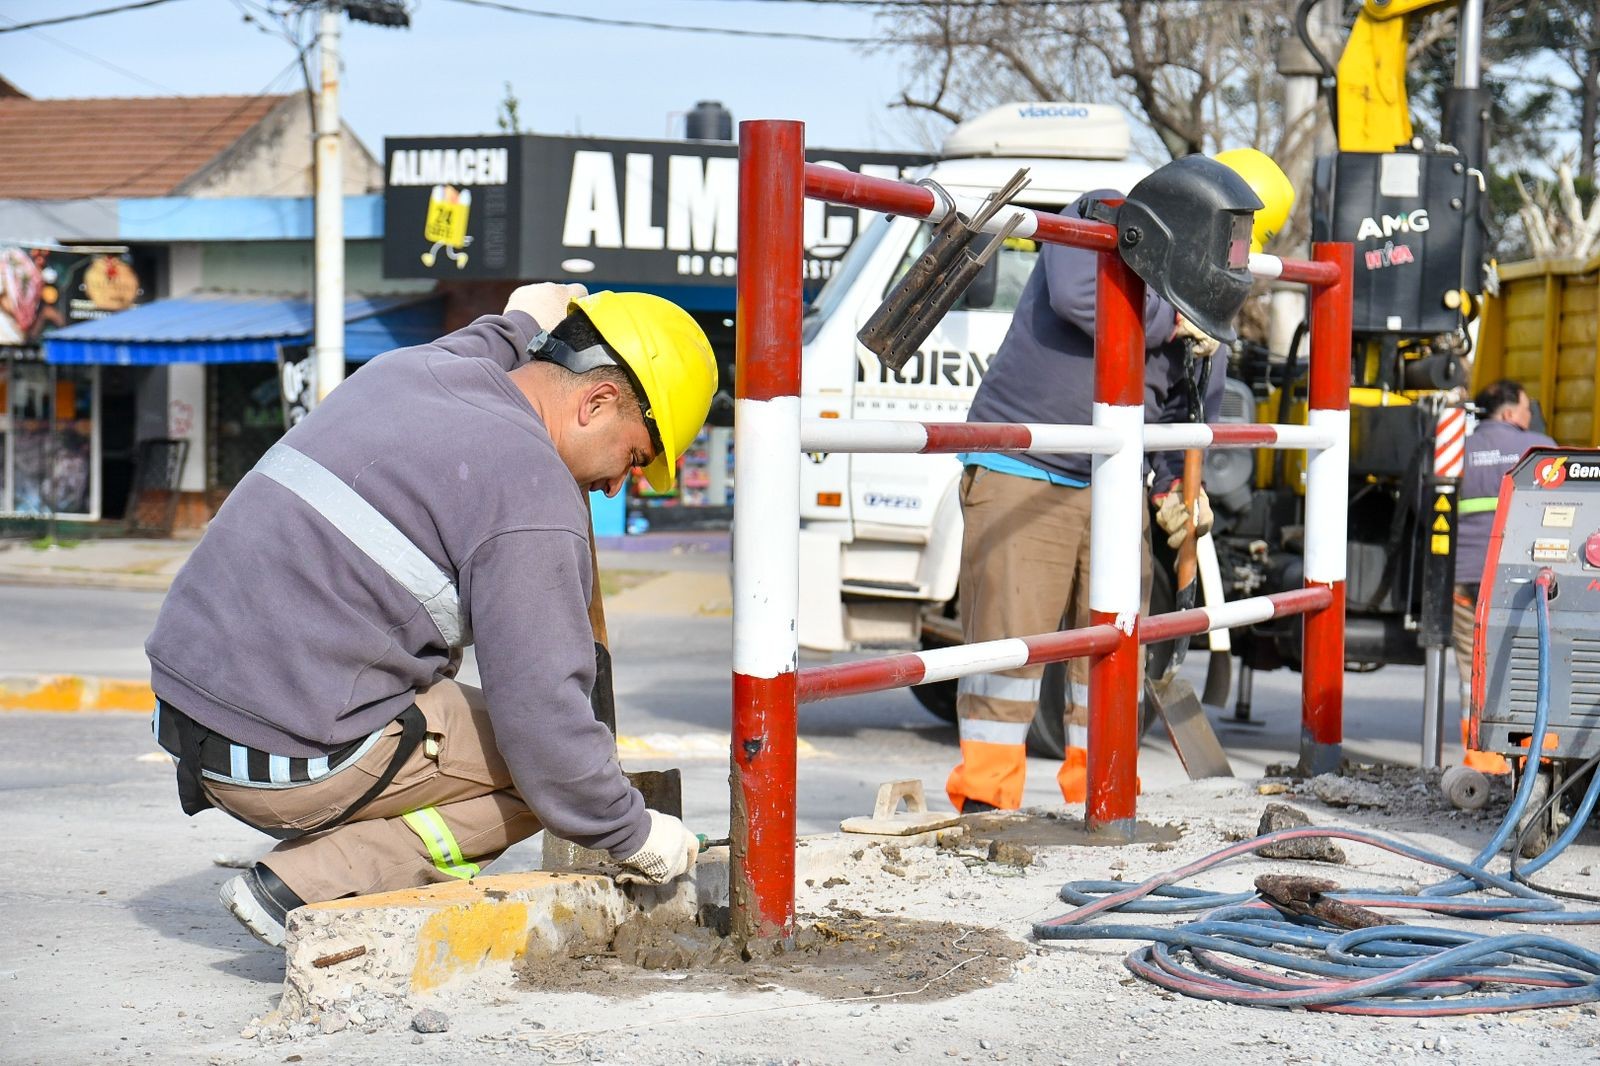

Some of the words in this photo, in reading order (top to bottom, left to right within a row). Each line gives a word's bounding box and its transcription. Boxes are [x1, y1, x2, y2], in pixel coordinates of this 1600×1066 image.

[389, 148, 508, 186] ALMACEN
[677, 254, 705, 275] NO
[1569, 462, 1600, 478] Gen
